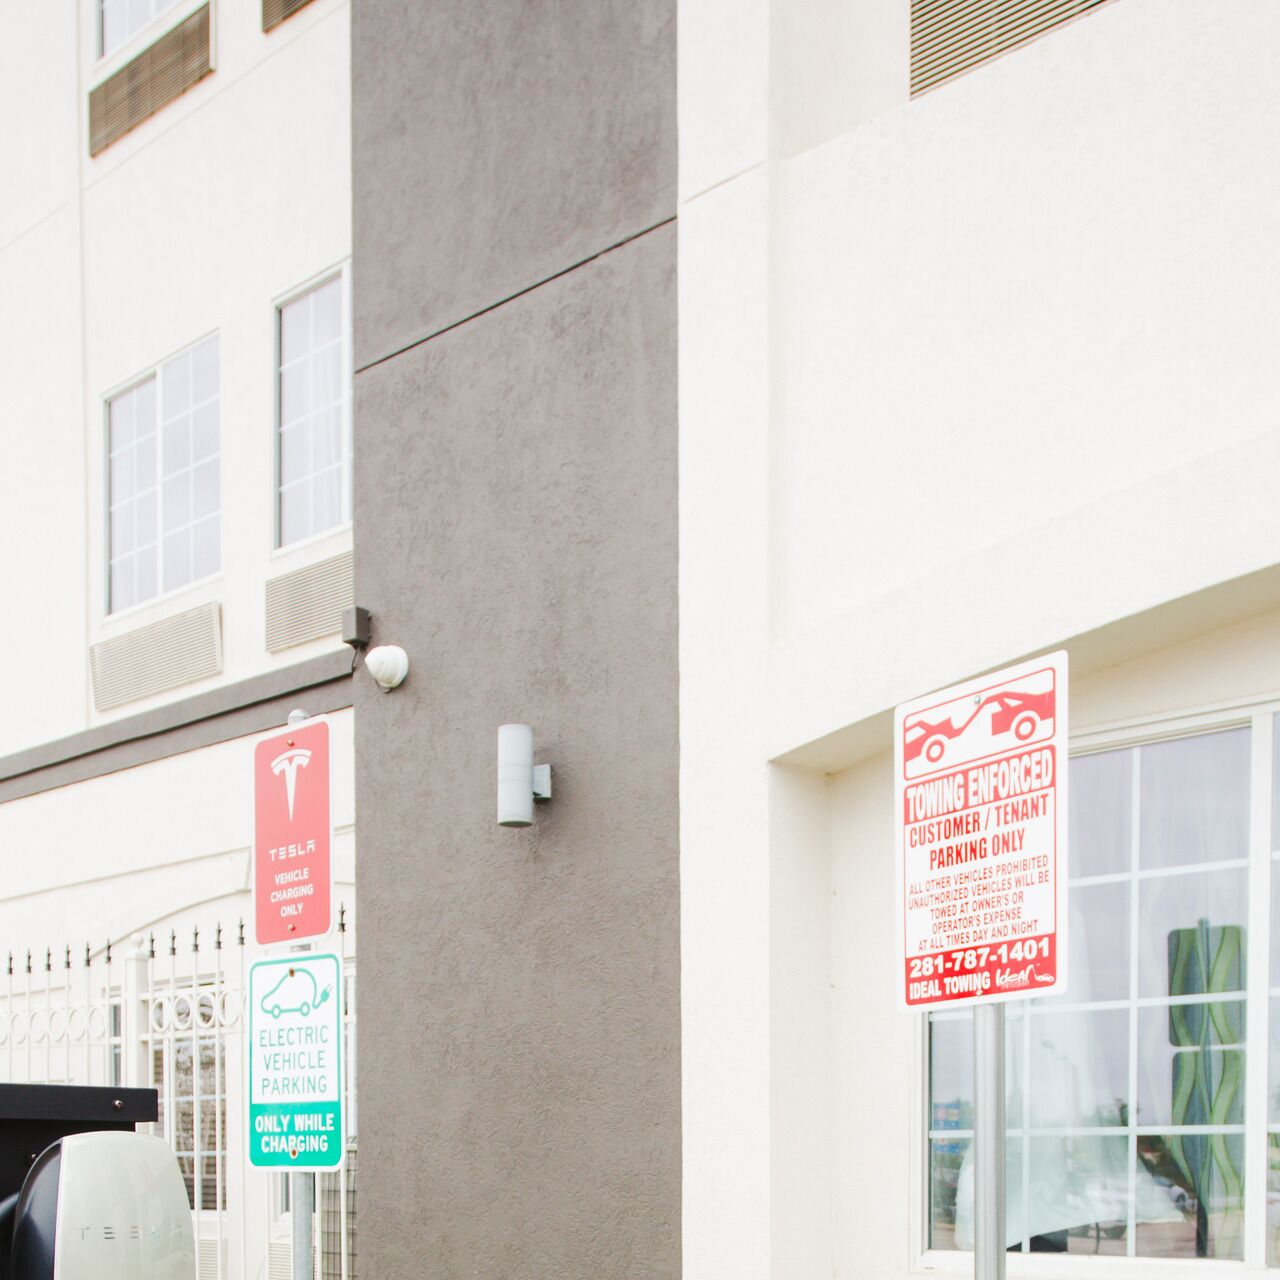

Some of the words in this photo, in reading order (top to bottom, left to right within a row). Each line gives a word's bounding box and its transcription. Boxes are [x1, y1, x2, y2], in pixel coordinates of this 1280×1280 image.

[906, 773, 965, 823] TOWING
[968, 749, 1053, 806] ENFORCED
[909, 811, 980, 848] CUSTOMER
[994, 793, 1049, 828] TENANT
[269, 839, 316, 862] TESLA
[929, 837, 987, 871] PARKING
[991, 827, 1026, 856] ONLY
[275, 867, 309, 885] VEHICLE
[909, 882, 923, 896] ALL
[925, 875, 952, 892] OTHER
[953, 867, 993, 887] VEHICLES
[995, 854, 1049, 878] PROHIBITED
[271, 884, 313, 902] CHARGING
[908, 887, 969, 911] UNAUTHORIZED
[971, 879, 1012, 897] VEHICLES
[1014, 874, 1035, 888] WILL
[1038, 870, 1050, 883] BE
[280, 902, 304, 918] ONLY
[930, 904, 958, 921] TOWED
[959, 901, 970, 915] AT
[971, 893, 1009, 913] OWNER'S
[1012, 891, 1025, 904] OR
[983, 906, 1022, 926] EXPENSE
[918, 938, 928, 952] AT
[930, 935, 944, 950] ALL
[946, 930, 970, 946] TIMES
[972, 928, 989, 943] DAY
[991, 924, 1009, 939] AND
[1011, 919, 1039, 936] NIGHT
[910, 937, 1049, 979] 281-787-1401
[910, 979, 942, 1000] IDEAL
[943, 971, 990, 995] TOWING
[260, 1025, 328, 1047] ELECTRIC
[263, 1050, 327, 1072] VEHICLE
[261, 1075, 327, 1096] PARKING
[255, 1115, 290, 1132] ONLY
[294, 1113, 335, 1131] WHILE
[261, 1135, 328, 1153] CHARGING
